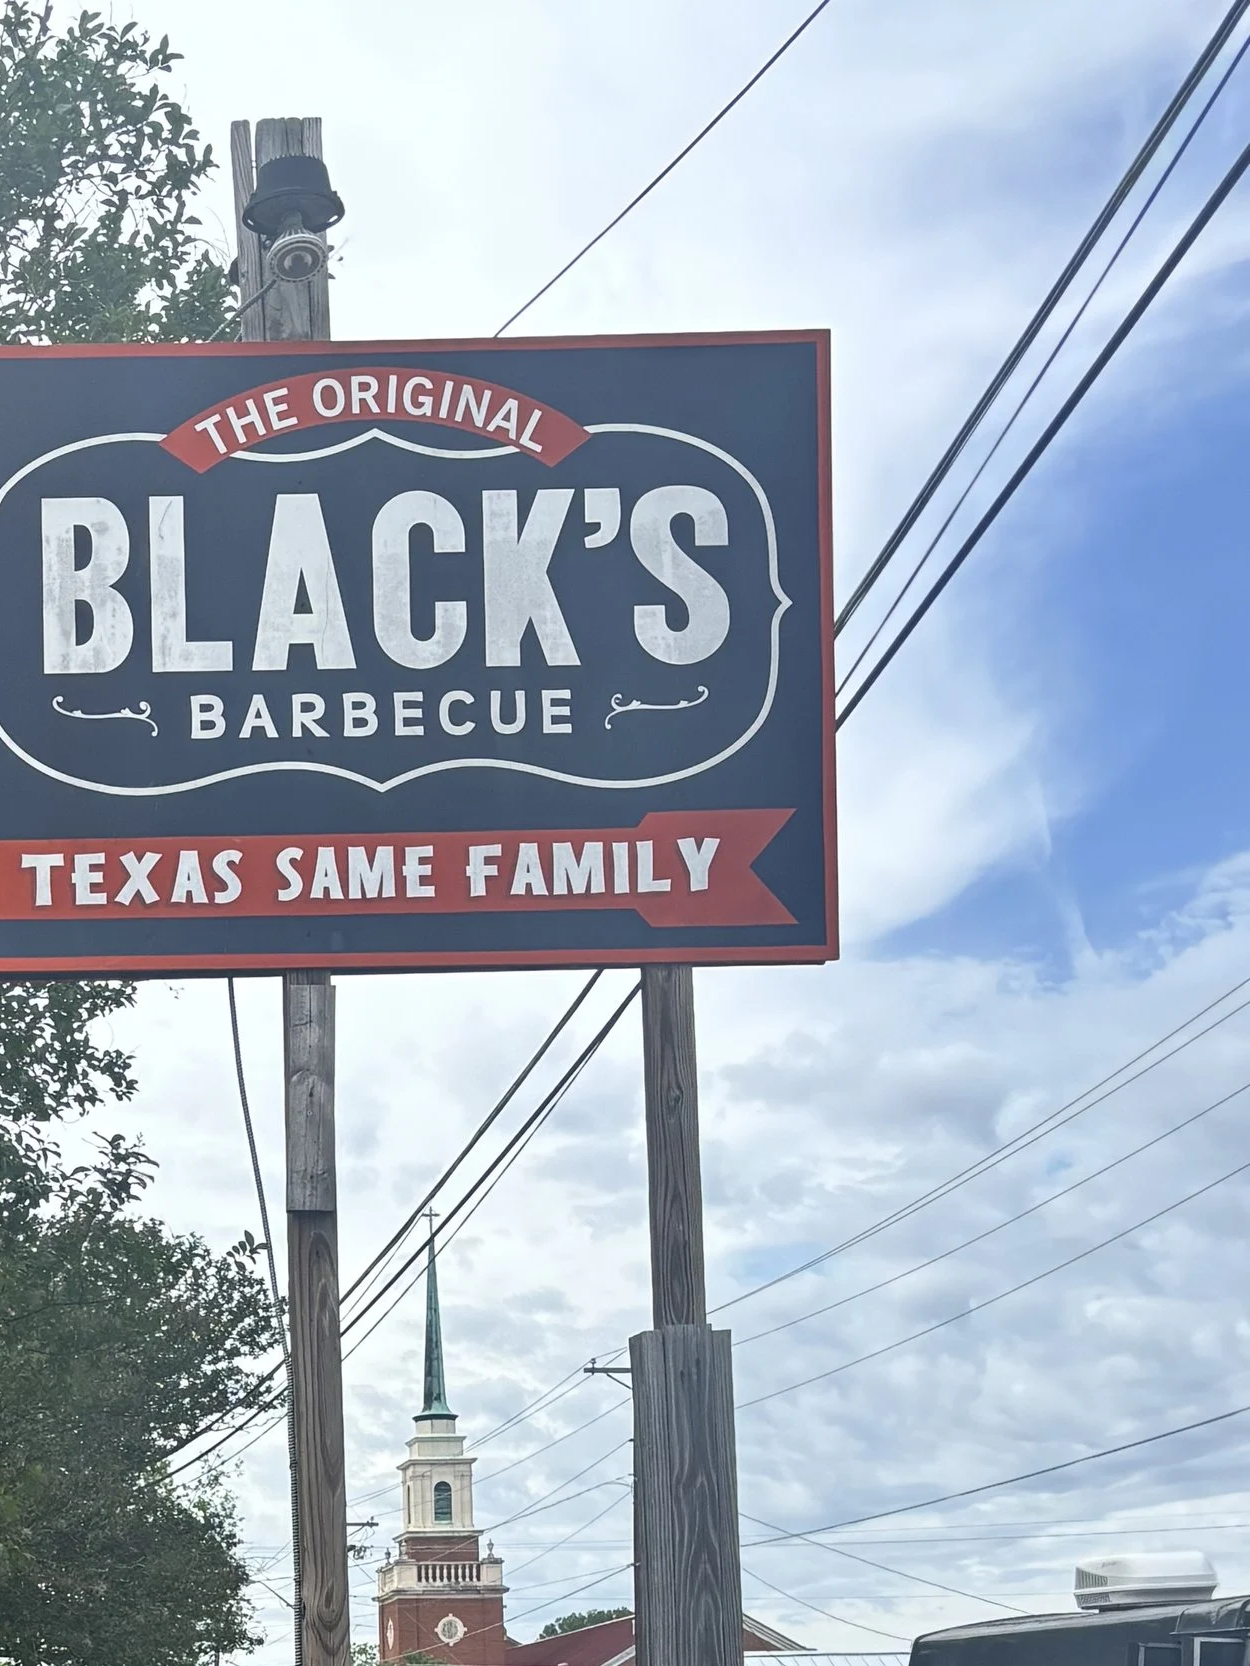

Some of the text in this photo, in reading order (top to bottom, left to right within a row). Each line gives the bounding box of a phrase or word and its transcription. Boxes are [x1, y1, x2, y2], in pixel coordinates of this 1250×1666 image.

[192, 376, 546, 459] THE ORIGINAL
[40, 484, 731, 676] BLACK'S
[189, 688, 575, 742] BARBECUE
[20, 848, 242, 906] TEXAS
[276, 844, 435, 903] SAME
[466, 836, 721, 899] FAMILY
